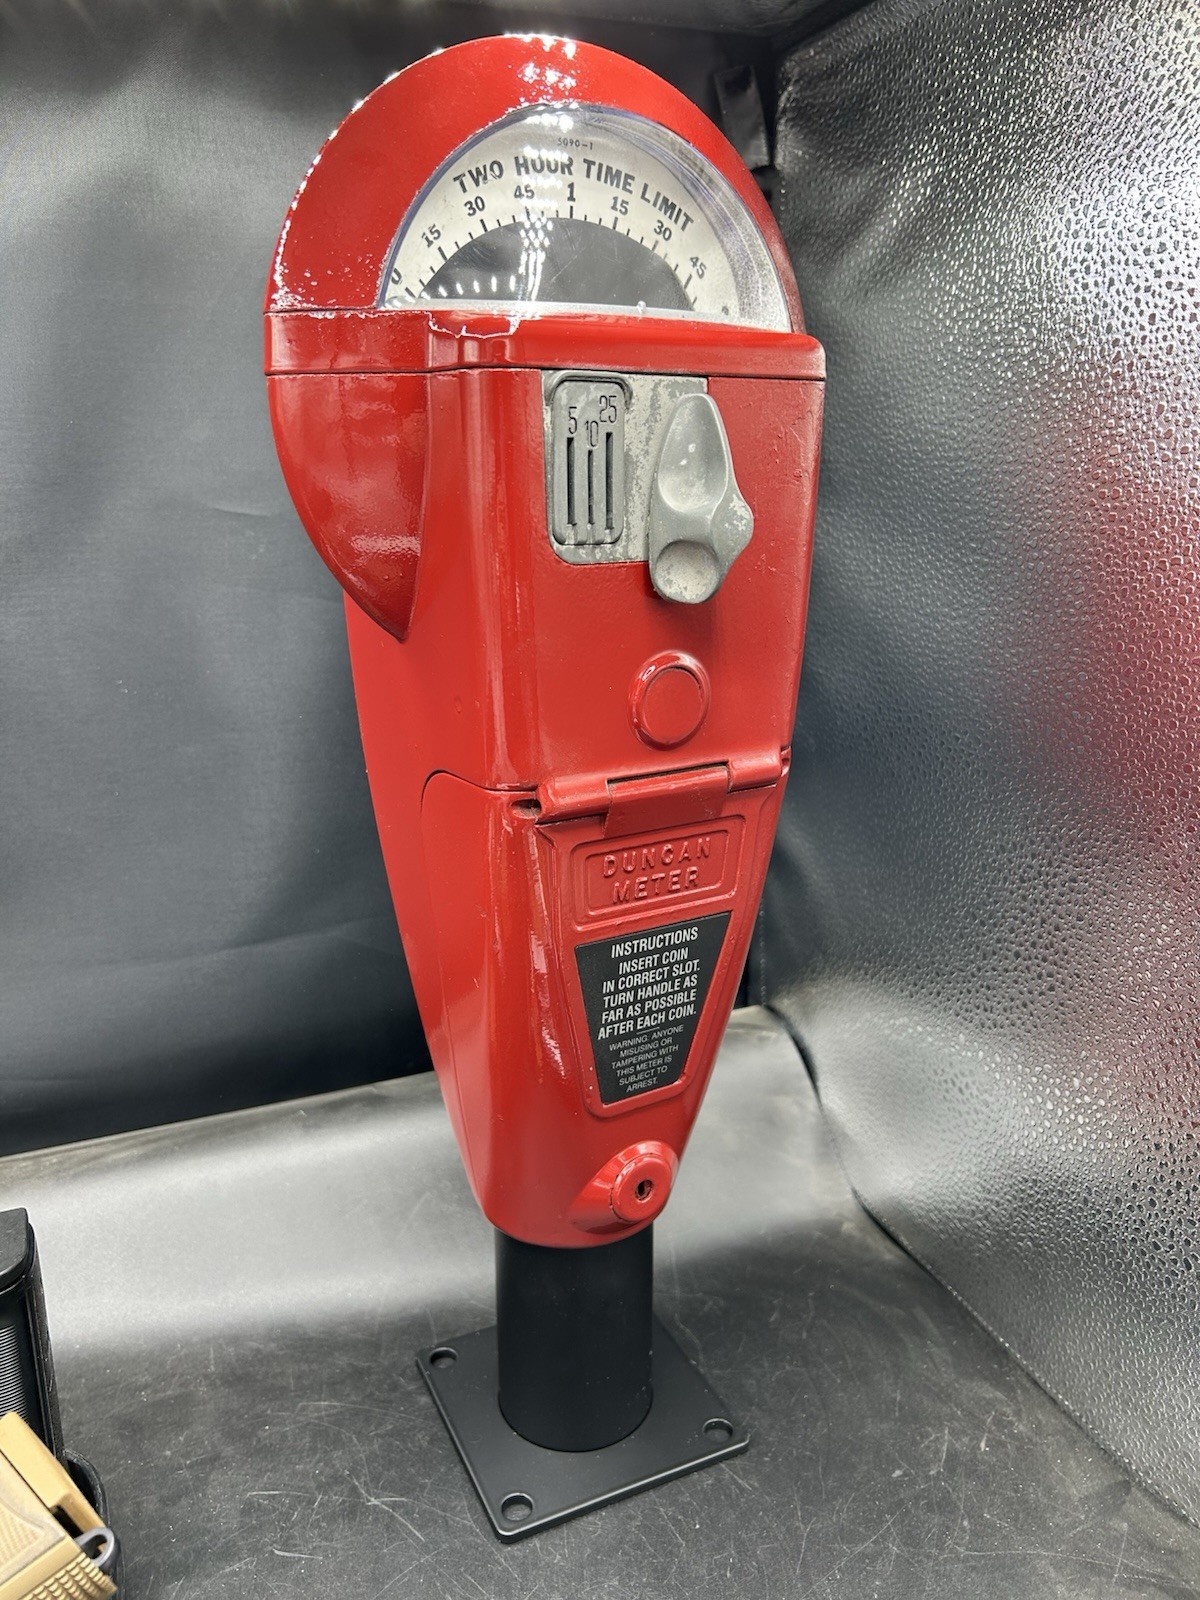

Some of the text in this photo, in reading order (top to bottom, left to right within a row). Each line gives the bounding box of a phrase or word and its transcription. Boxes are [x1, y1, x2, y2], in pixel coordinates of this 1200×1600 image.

[453, 155, 695, 233] TWO HOUR TIME LIMIT
[422, 223, 442, 249] 15
[464, 195, 486, 217] 30
[513, 183, 535, 200] 45
[567, 181, 576, 203] 1
[611, 196, 630, 217] 15
[653, 220, 673, 242] 30
[690, 256, 707, 280] 45
[568, 395, 617, 447] 5 10 25
[603, 837, 711, 878] DUNCAN
[612, 866, 699, 904] METER
[611, 926, 699, 958] INSTRUCTIONS
[602, 959, 700, 994] IN CORRECT SLOT.
[618, 947, 689, 975] INSERT COIN
[602, 988, 697, 1024] FAR AS POSSIBLE
[603, 974, 698, 1009] TURN HANDLE AS
[597, 1003, 697, 1041] AFTER EACH COIN.
[651, 1024, 684, 1040] ANYONE
[611, 1044, 679, 1069] TAMPERING WITH
[619, 1036, 673, 1058] MISUSING OR
[616, 1054, 673, 1077] THIS METER IS
[619, 1065, 668, 1086] SUBJECT TO
